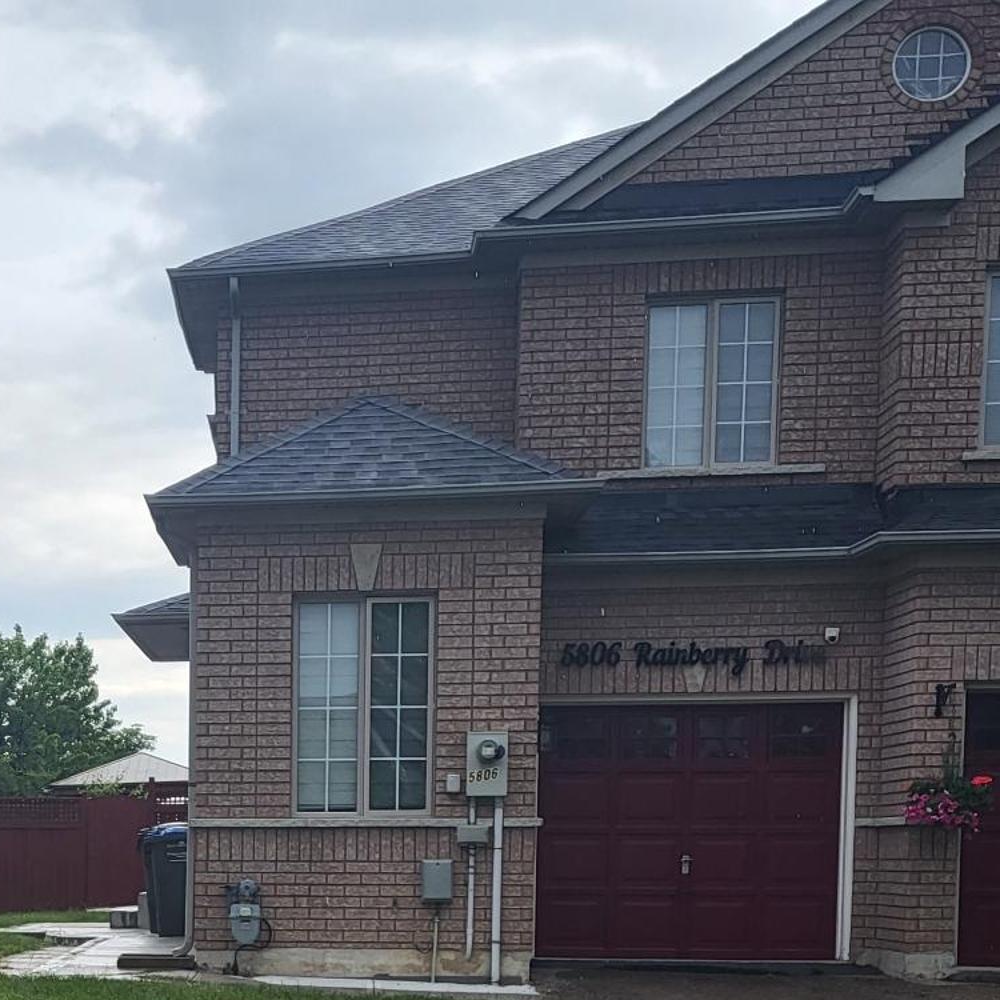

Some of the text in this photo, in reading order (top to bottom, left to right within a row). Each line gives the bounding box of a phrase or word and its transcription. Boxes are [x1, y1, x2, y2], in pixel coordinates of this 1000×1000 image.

[561, 640, 622, 668] 5806
[634, 641, 749, 677] Rainberry
[469, 767, 498, 784] 5806
